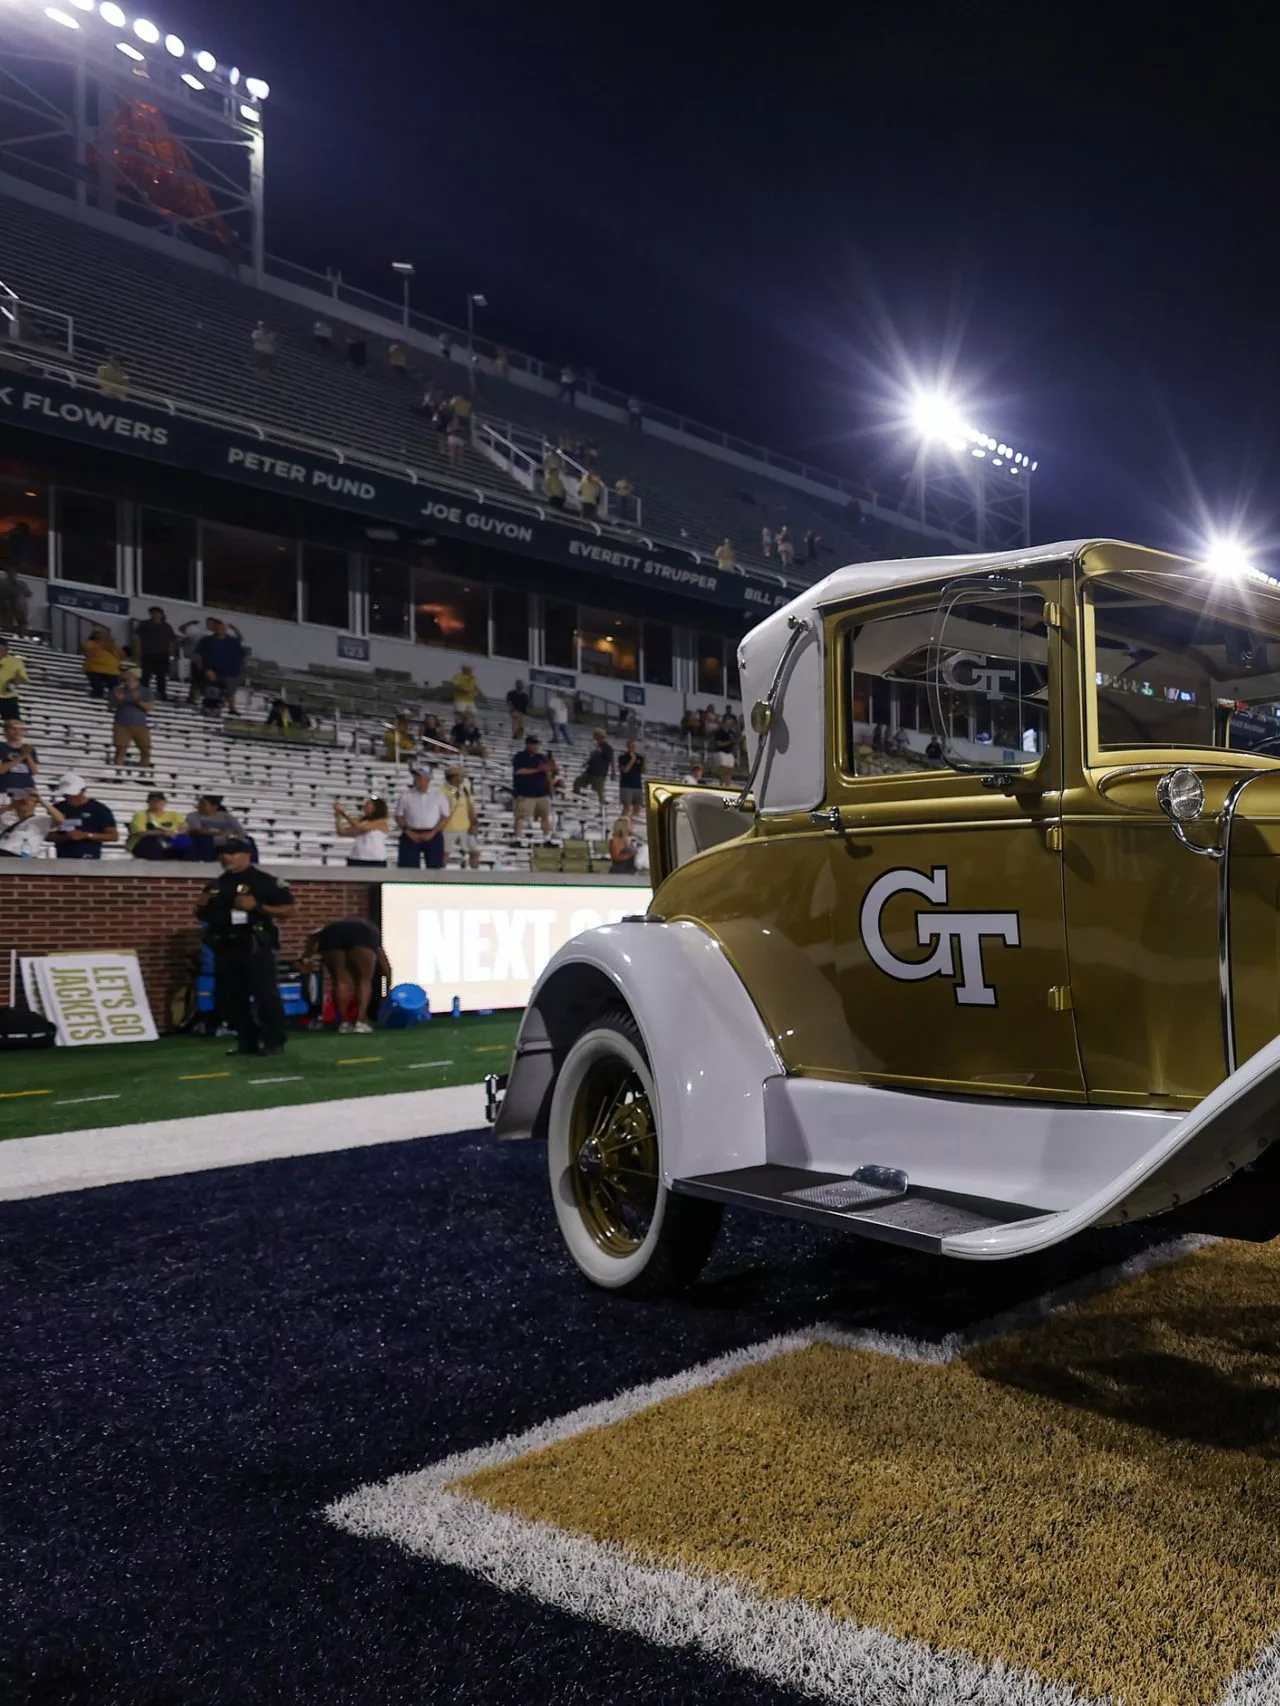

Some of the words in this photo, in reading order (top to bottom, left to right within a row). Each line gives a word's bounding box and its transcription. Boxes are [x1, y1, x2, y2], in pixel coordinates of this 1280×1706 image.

[22, 391, 169, 445] FLOWERS
[228, 447, 306, 483] PETER
[312, 469, 376, 500] PUND
[420, 501, 462, 527] JOE
[465, 512, 533, 543] GUYON
[568, 539, 642, 571] EVERETT
[643, 560, 718, 591] STRUPPER
[743, 587, 772, 606] BILL
[943, 651, 1015, 700] GT
[417, 908, 557, 985] NEXT
[859, 865, 1021, 1008] GT
[49, 966, 107, 1041] JACKETS
[91, 966, 137, 1009] LET'S
[106, 1013, 146, 1037] GO
